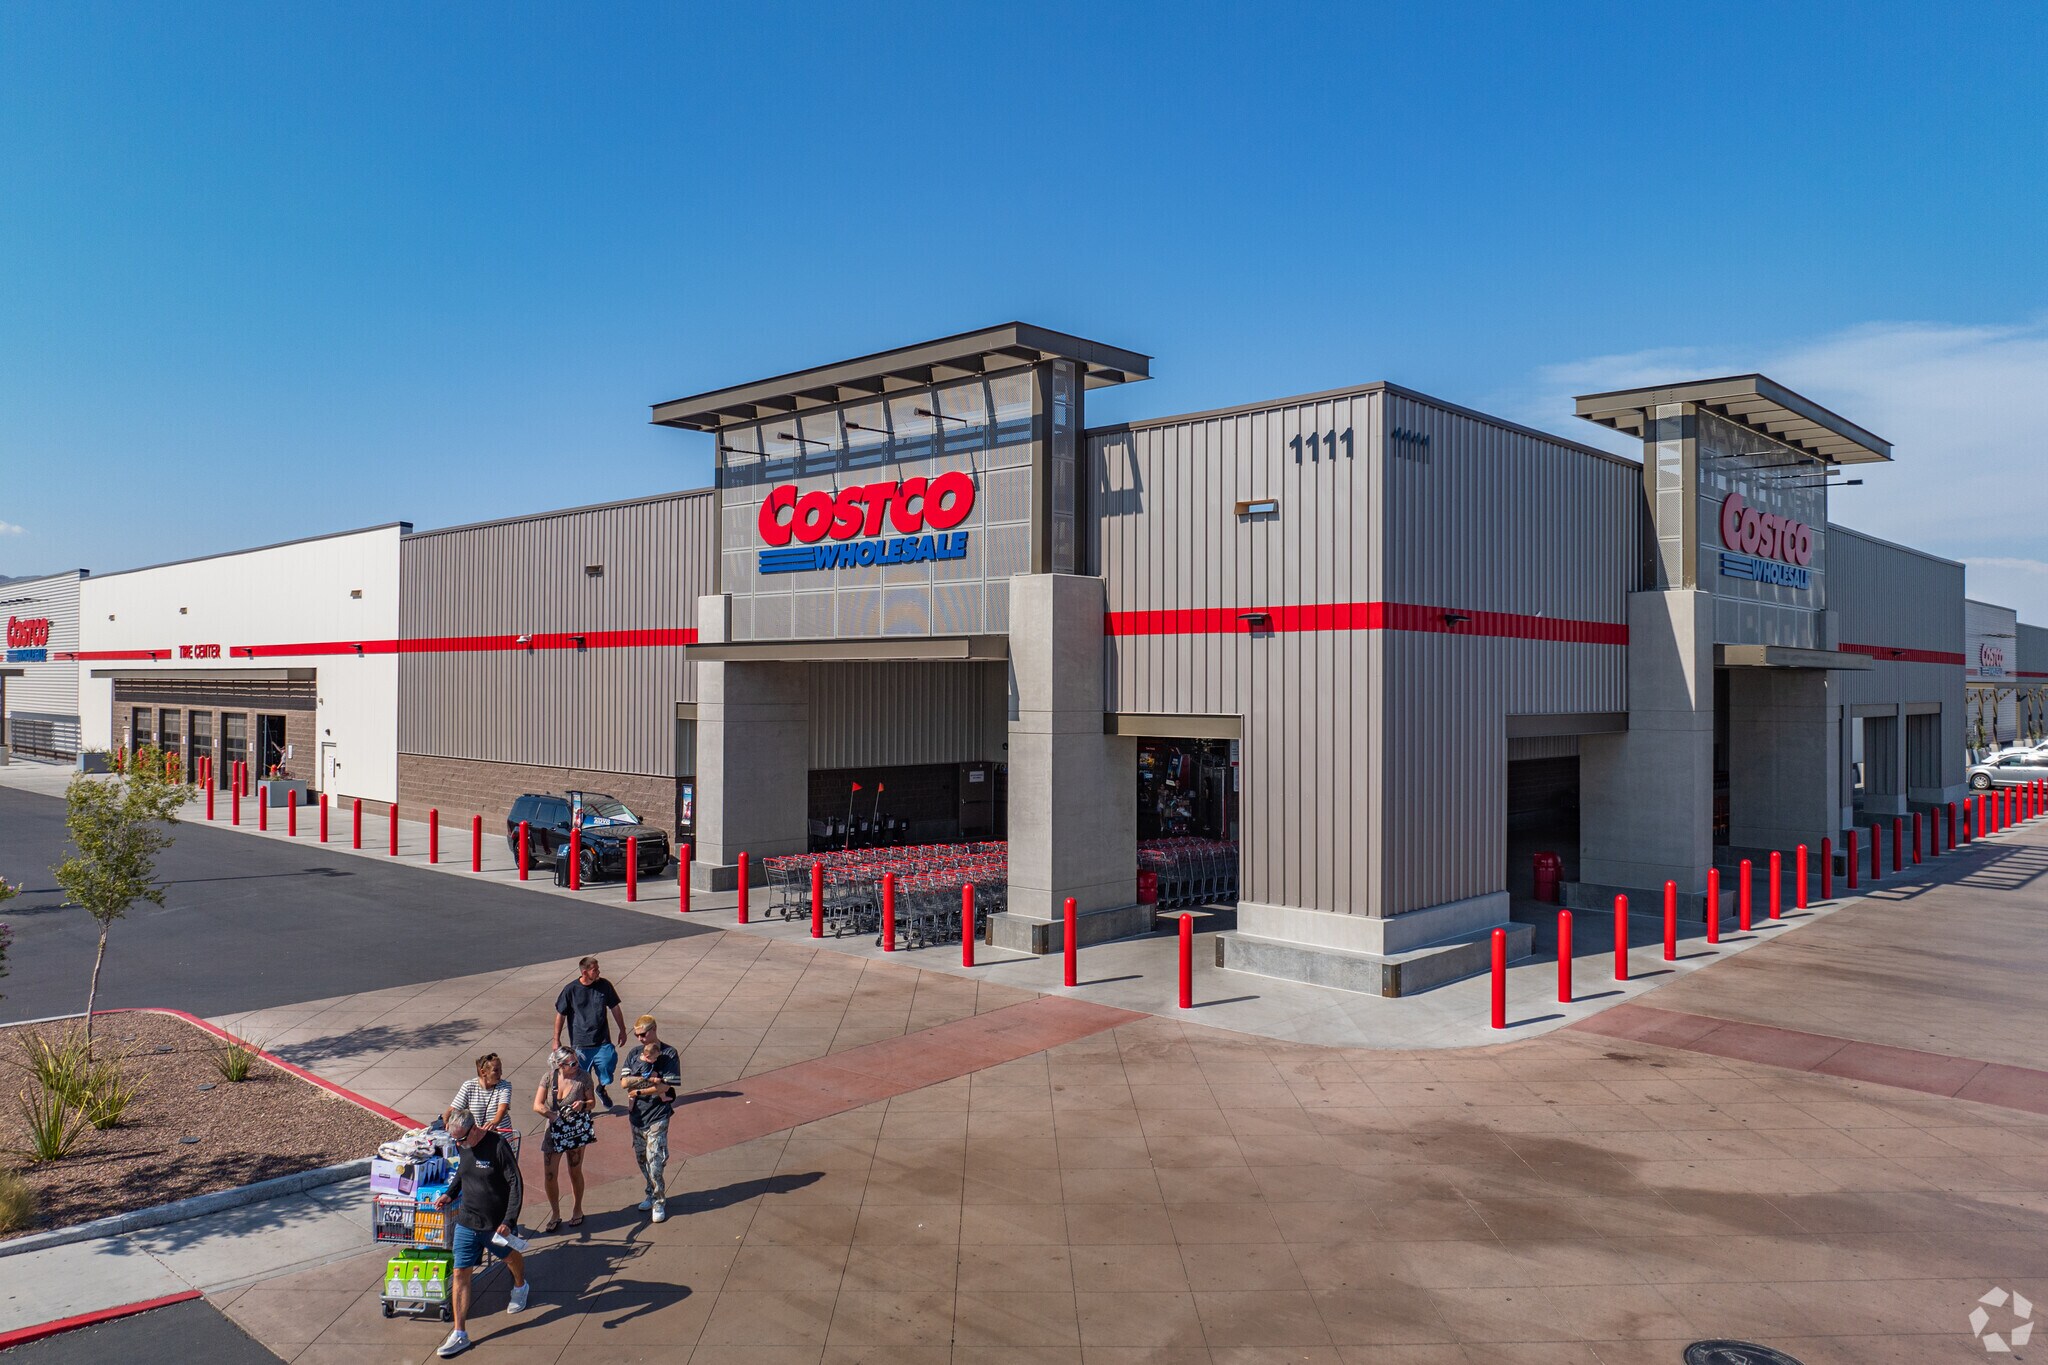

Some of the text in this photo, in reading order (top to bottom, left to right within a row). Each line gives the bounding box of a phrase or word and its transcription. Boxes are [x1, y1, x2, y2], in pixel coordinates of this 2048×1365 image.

[1289, 427, 1353, 464] 1111
[758, 471, 975, 546] COSTCO
[1720, 492, 1812, 566] COSTCO
[814, 532, 968, 570] WHOLESALE
[7, 615, 49, 648] COSTCO
[178, 643, 221, 659] TIRE CENTER
[1980, 644, 2004, 667] COSTCO
